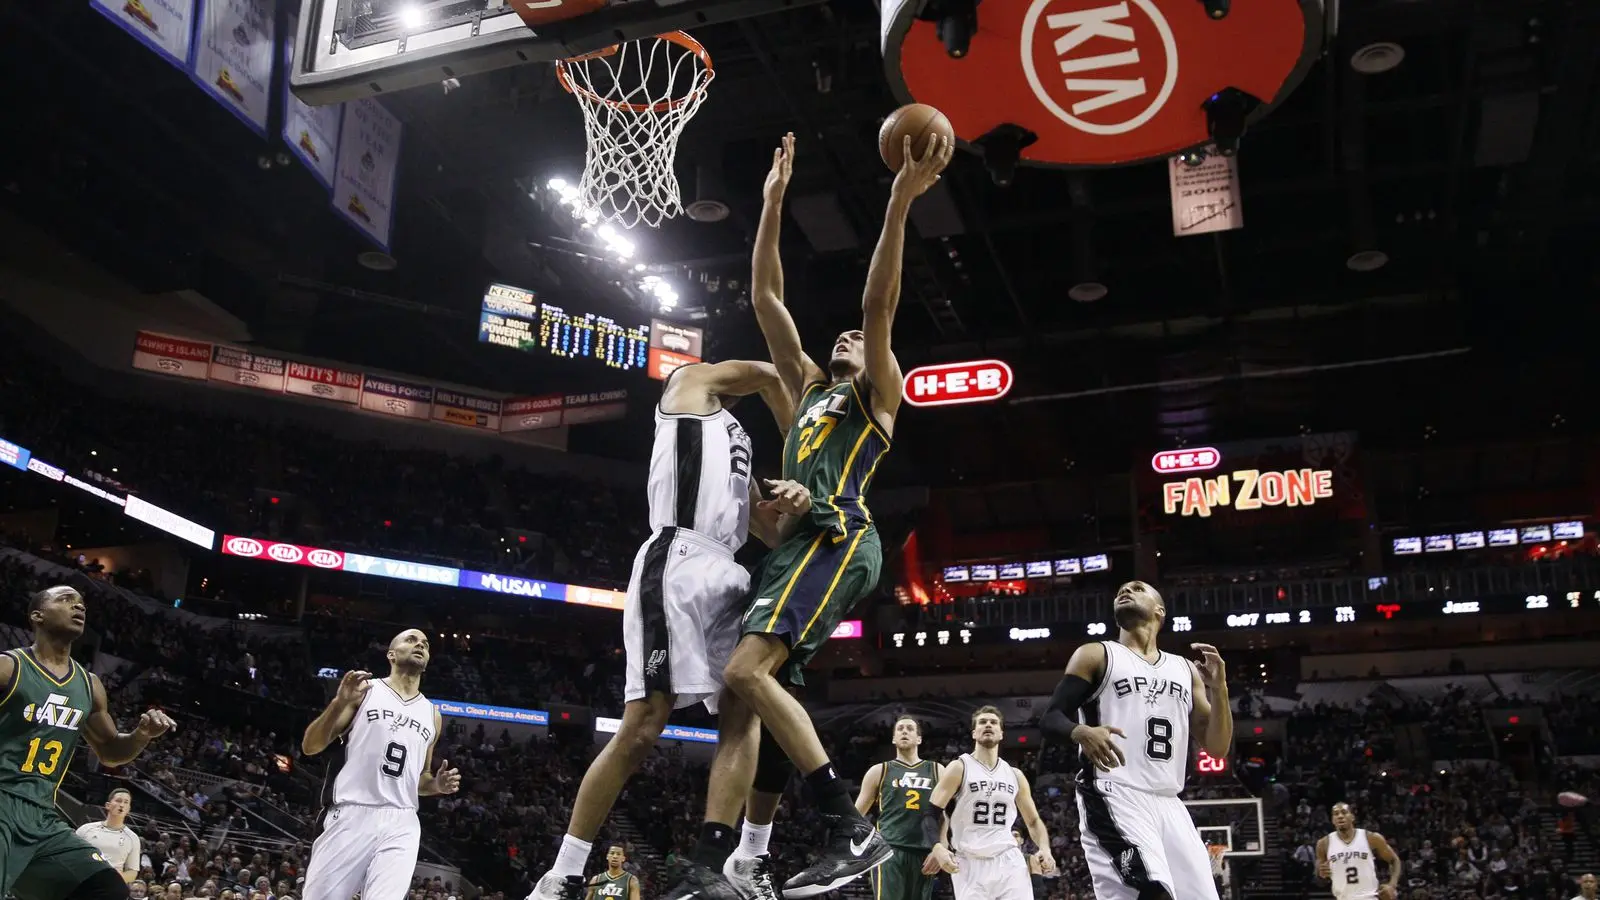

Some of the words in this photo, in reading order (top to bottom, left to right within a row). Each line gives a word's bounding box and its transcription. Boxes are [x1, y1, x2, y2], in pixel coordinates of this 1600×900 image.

[1046, 1, 1147, 116] KIA
[176, 345, 209, 358] ISLAND
[291, 363, 333, 382] PATTY'S
[365, 380, 396, 393] AYRES
[398, 386, 430, 399] FORCE
[565, 394, 588, 405] TEAM
[797, 415, 838, 464] 27
[1163, 475, 1231, 517] FAN
[1233, 468, 1333, 511] ZONE
[385, 561, 453, 583] VALERO
[502, 579, 543, 597] USAA
[1442, 601, 1480, 614] Jazz
[1526, 595, 1548, 609] 22
[1299, 610, 1311, 623] 2
[1009, 627, 1050, 641] Spurs
[24, 693, 84, 731] JAZZ
[366, 708, 431, 742] SPURS
[1146, 716, 1173, 762] 8
[21, 737, 63, 776] 13
[381, 741, 407, 778] 9
[894, 772, 932, 790] JAZZ
[969, 780, 1015, 795] SPURS
[905, 790, 920, 810] 2
[973, 801, 1007, 825] 22
[1330, 851, 1368, 863] SPURS
[1345, 867, 1359, 884] 2
[598, 883, 624, 897] JAZZ
